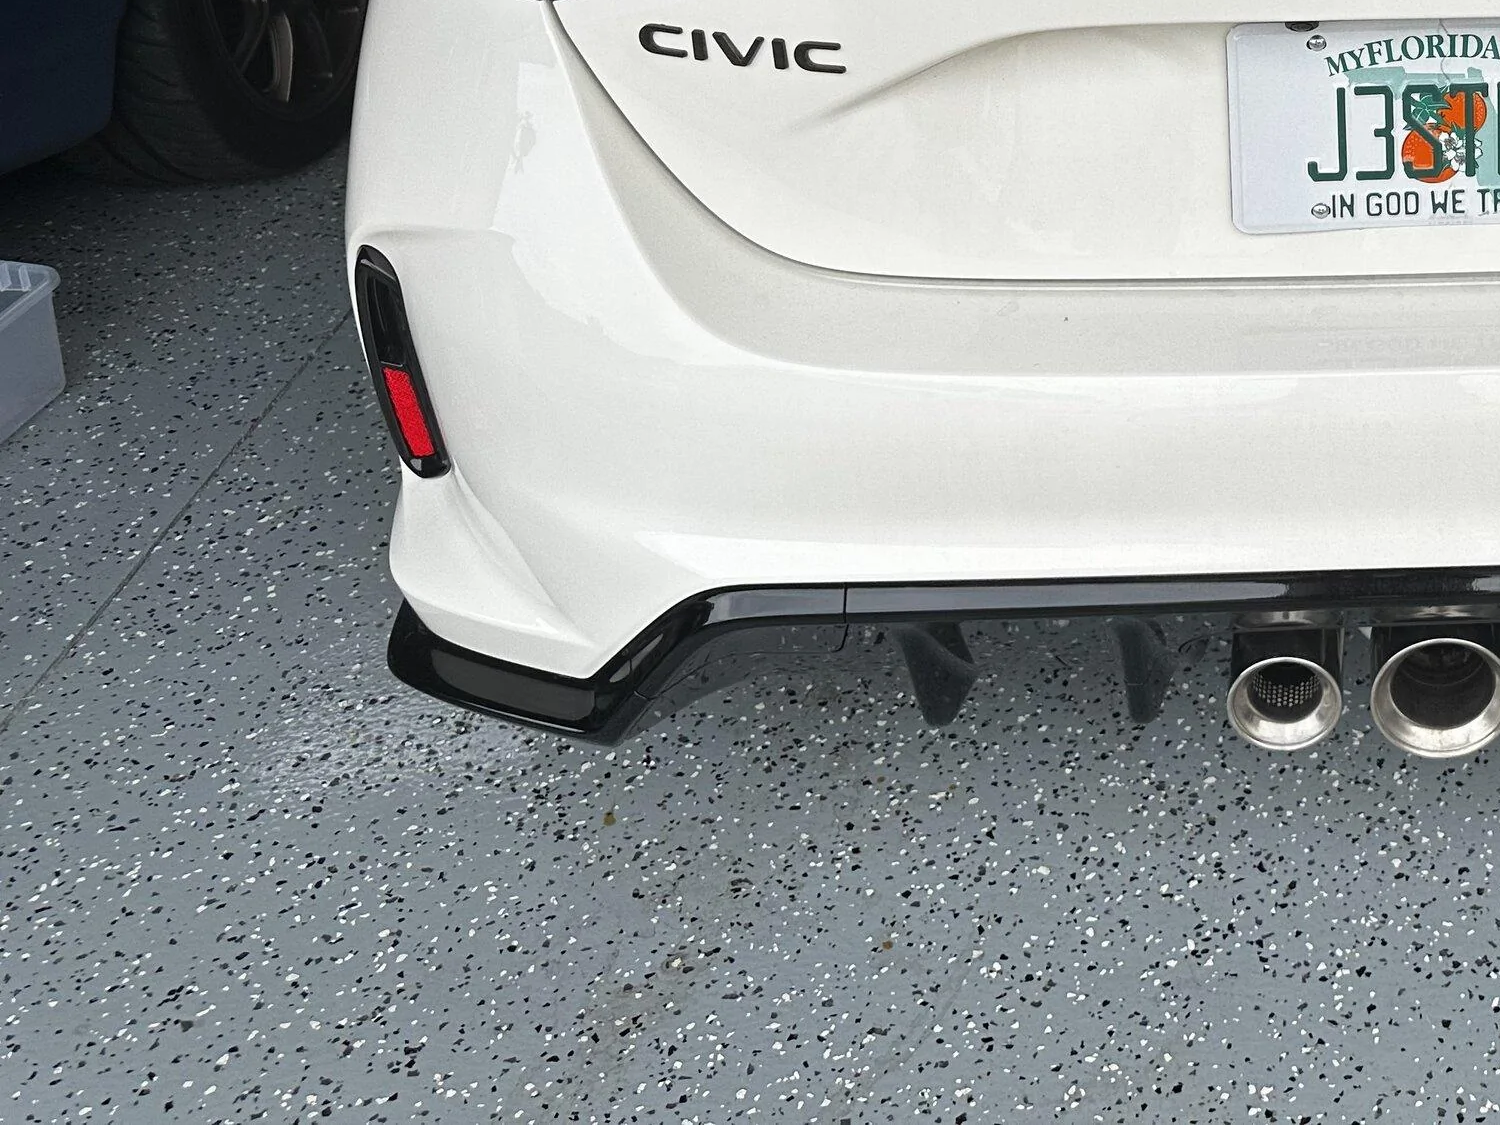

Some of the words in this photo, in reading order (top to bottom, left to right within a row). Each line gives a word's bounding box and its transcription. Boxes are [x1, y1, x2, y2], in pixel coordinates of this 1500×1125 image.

[638, 22, 847, 74] CIVIC
[1331, 192, 1355, 219] IN
[1366, 190, 1420, 217] GOD
[1430, 188, 1465, 215] WE
